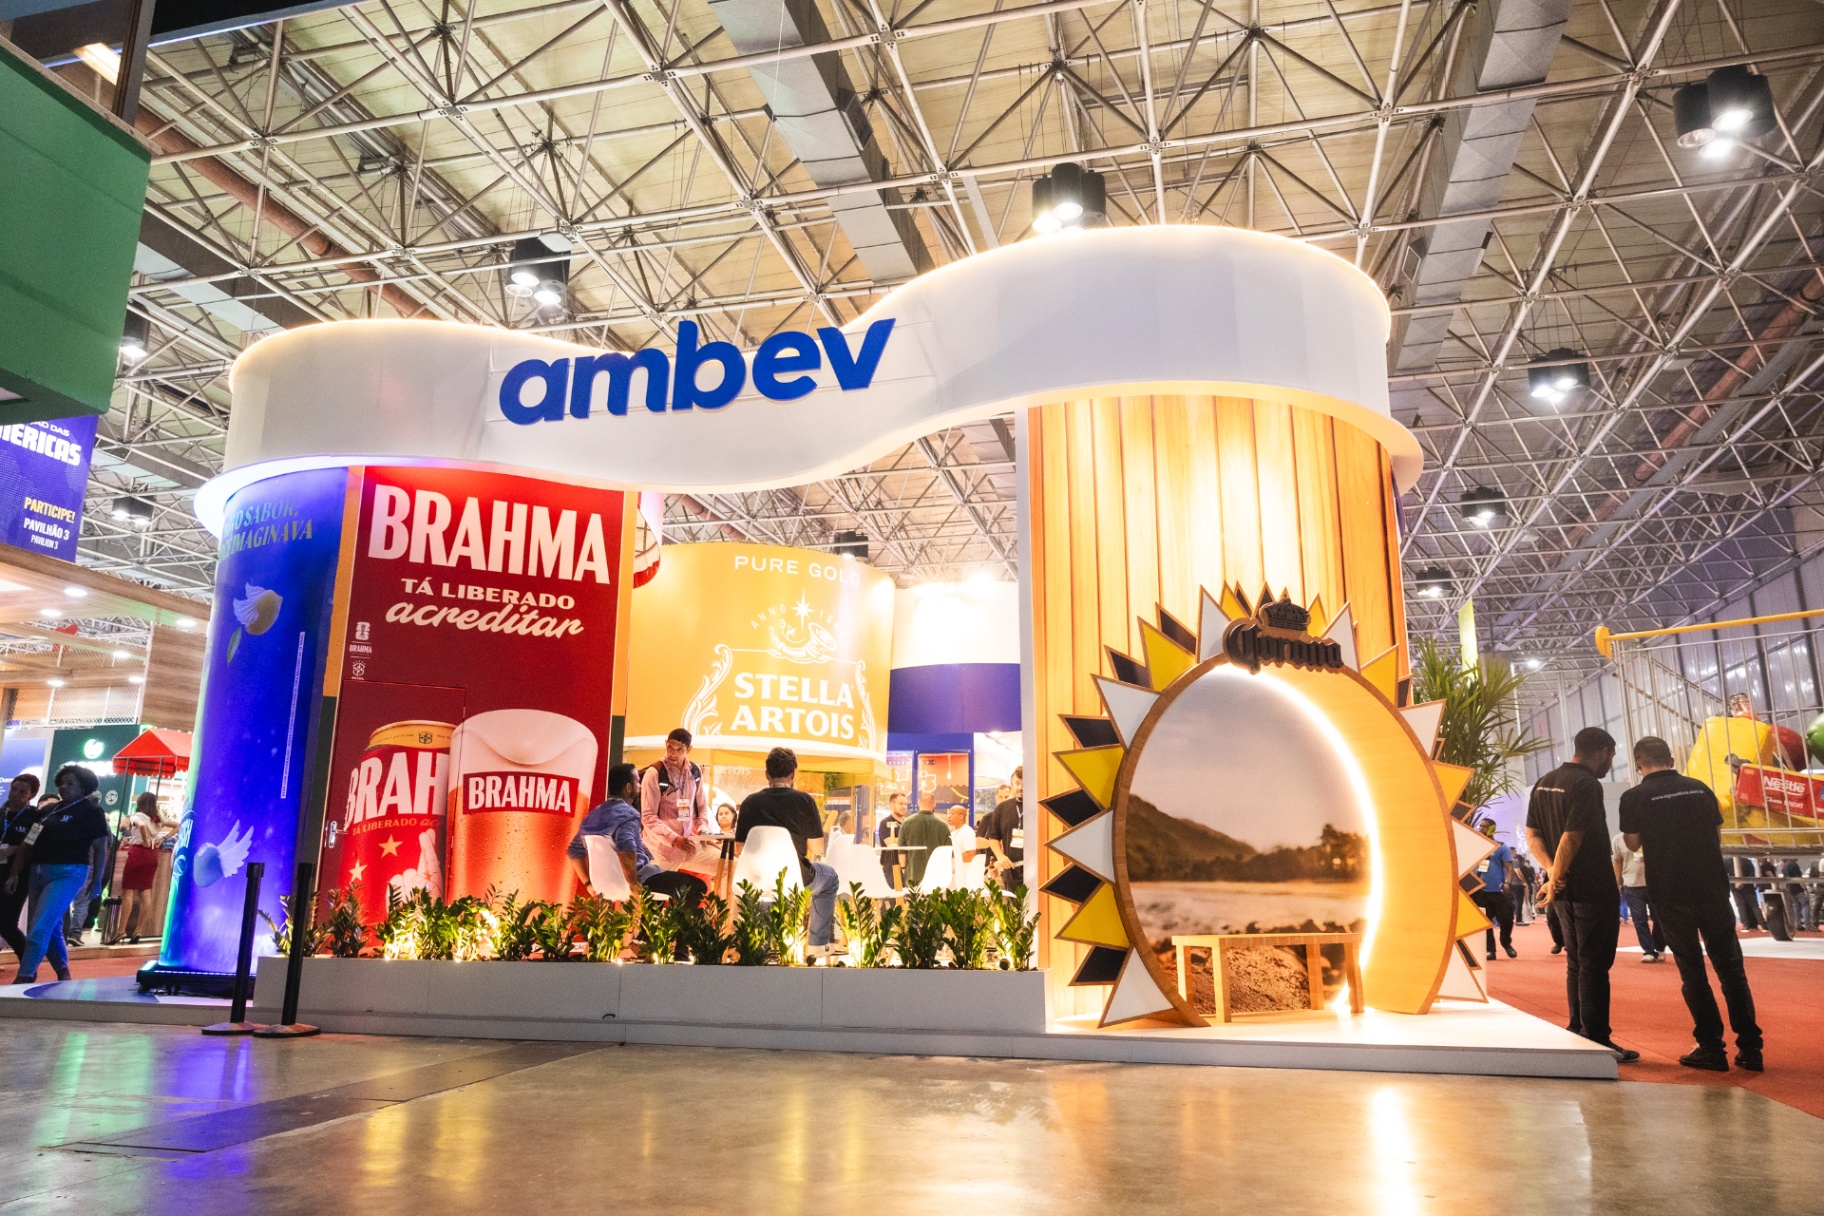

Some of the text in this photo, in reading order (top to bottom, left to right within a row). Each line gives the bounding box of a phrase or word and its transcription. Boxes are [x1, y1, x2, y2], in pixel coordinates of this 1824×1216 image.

[499, 318, 896, 426] ambev
[50, 424, 70, 437] DAS
[24, 496, 76, 524] PARTICIPE!
[24, 518, 70, 541] PAVILHÃO 3
[31, 534, 59, 550] PAVILION 3
[368, 484, 610, 584] BRAHMA
[734, 556, 860, 586] PURE GOLD
[401, 577, 575, 610] TÁ LIBERADO
[386, 602, 584, 639] acreditar
[750, 604, 787, 630] ANNO
[349, 644, 372, 654] BRAHMA
[1226, 622, 1344, 674] Corona
[734, 672, 854, 709] STELLA
[730, 705, 854, 740] ARTOIS
[468, 775, 571, 813] BRAHMA
[362, 818, 418, 832] LIBERADO
